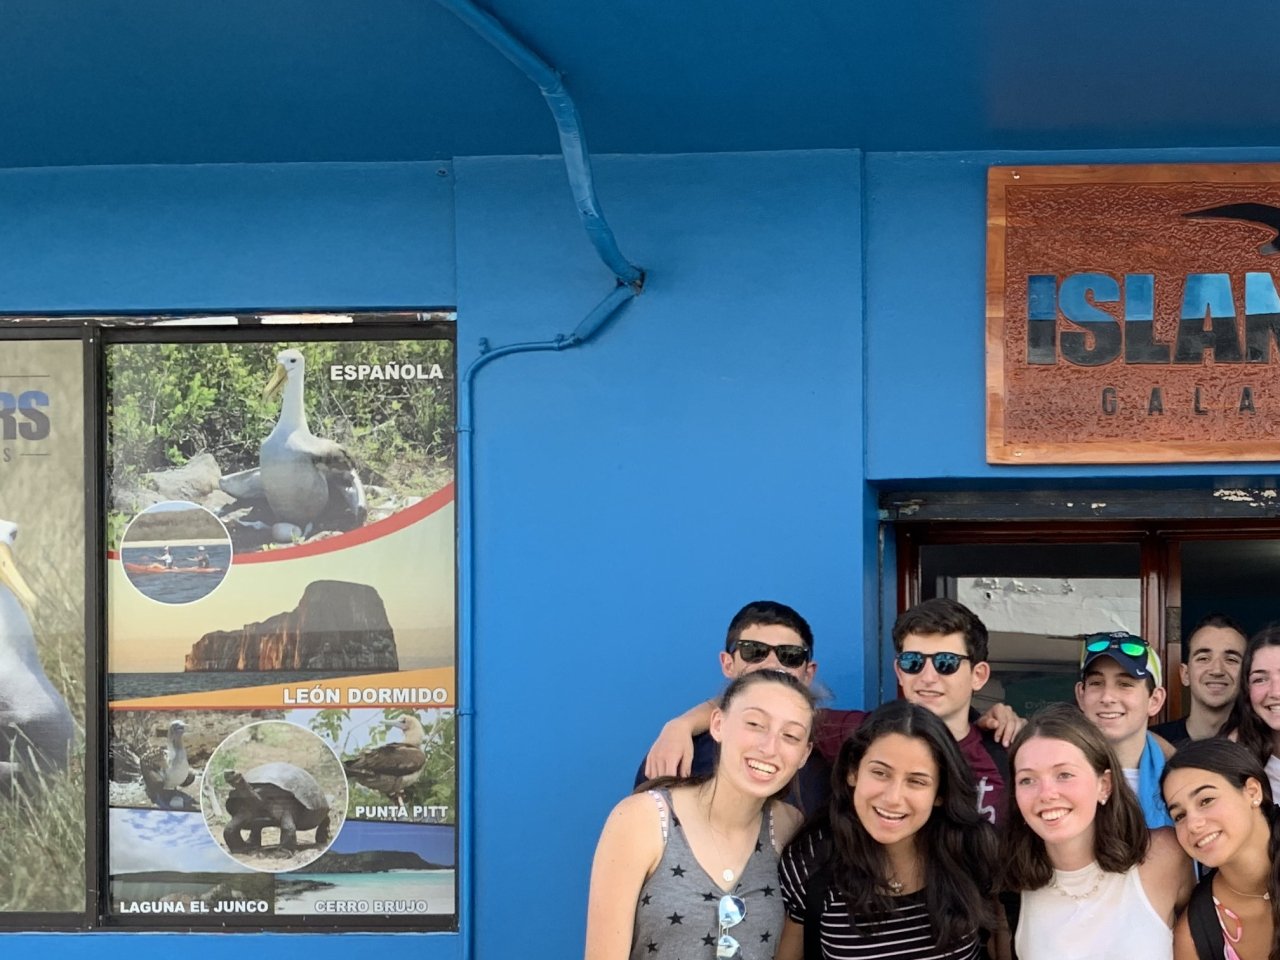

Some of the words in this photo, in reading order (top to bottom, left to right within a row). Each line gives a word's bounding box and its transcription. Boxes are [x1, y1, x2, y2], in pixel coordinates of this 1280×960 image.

[330, 361, 444, 381] ESPAÑOLA
[283, 684, 340, 704] LEÓN
[348, 687, 448, 704] DORMIDO
[355, 806, 408, 818] PUNTA
[413, 805, 449, 818] PITT
[120, 901, 185, 914] LAGUNA
[190, 900, 210, 913] EL
[213, 900, 269, 913] JUNCO
[314, 900, 369, 914] CERRO
[373, 900, 428, 913] BRUJO
